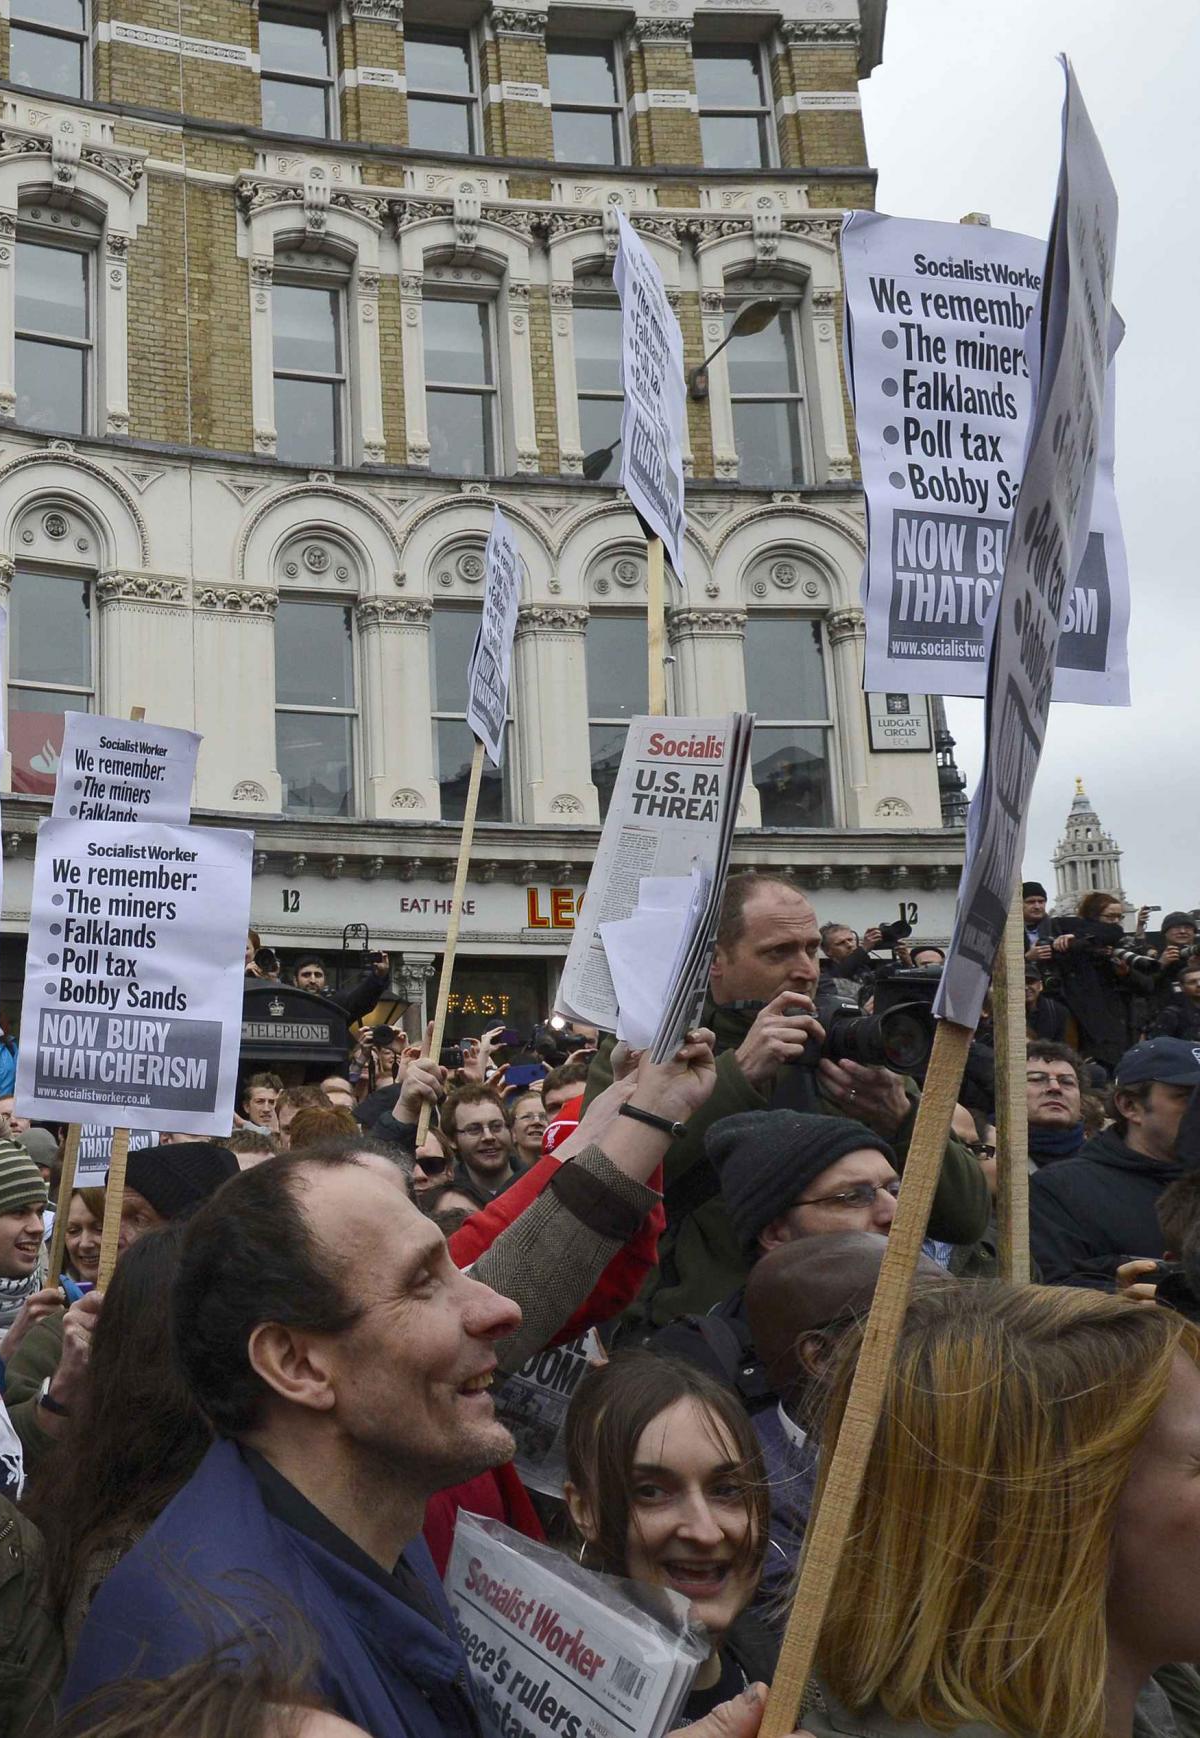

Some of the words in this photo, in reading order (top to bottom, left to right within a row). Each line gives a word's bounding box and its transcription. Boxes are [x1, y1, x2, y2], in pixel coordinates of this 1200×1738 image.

[991, 261, 1042, 291] Worke
[869, 276, 913, 316] We
[900, 322, 946, 366] The
[903, 368, 1018, 421] Falklands
[904, 416, 953, 460] Poll
[960, 424, 1003, 463] tax
[909, 462, 989, 514] Bobby
[897, 517, 970, 574] NOW
[878, 719, 921, 727] LUDGATE
[648, 733, 724, 759] Socialis
[75, 748, 94, 772] We
[99, 758, 166, 781] remember:
[83, 775, 105, 799] The
[109, 781, 151, 804] miners
[635, 769, 685, 794] U.S.
[52, 858, 81, 884] We
[88, 864, 198, 893] remember:
[65, 888, 101, 915] The
[108, 892, 177, 921] miners
[282, 889, 301, 912] 12
[400, 898, 430, 914] EAT
[899, 902, 918, 925] 12
[64, 918, 157, 950] Falklands
[61, 948, 99, 974] Poll
[104, 952, 137, 979] tax
[59, 978, 119, 1011] Bobby
[126, 984, 188, 1012] Sands
[41, 1014, 100, 1046] NOW
[106, 1017, 171, 1054] BURY
[248, 1024, 329, 1040] TELEPHONE
[39, 1047, 208, 1090] THATCHERISM
[37, 1086, 151, 1107] www.socialistworker.co.uk
[464, 1556, 535, 1637] Socialist
[532, 1605, 607, 1683] Worker
